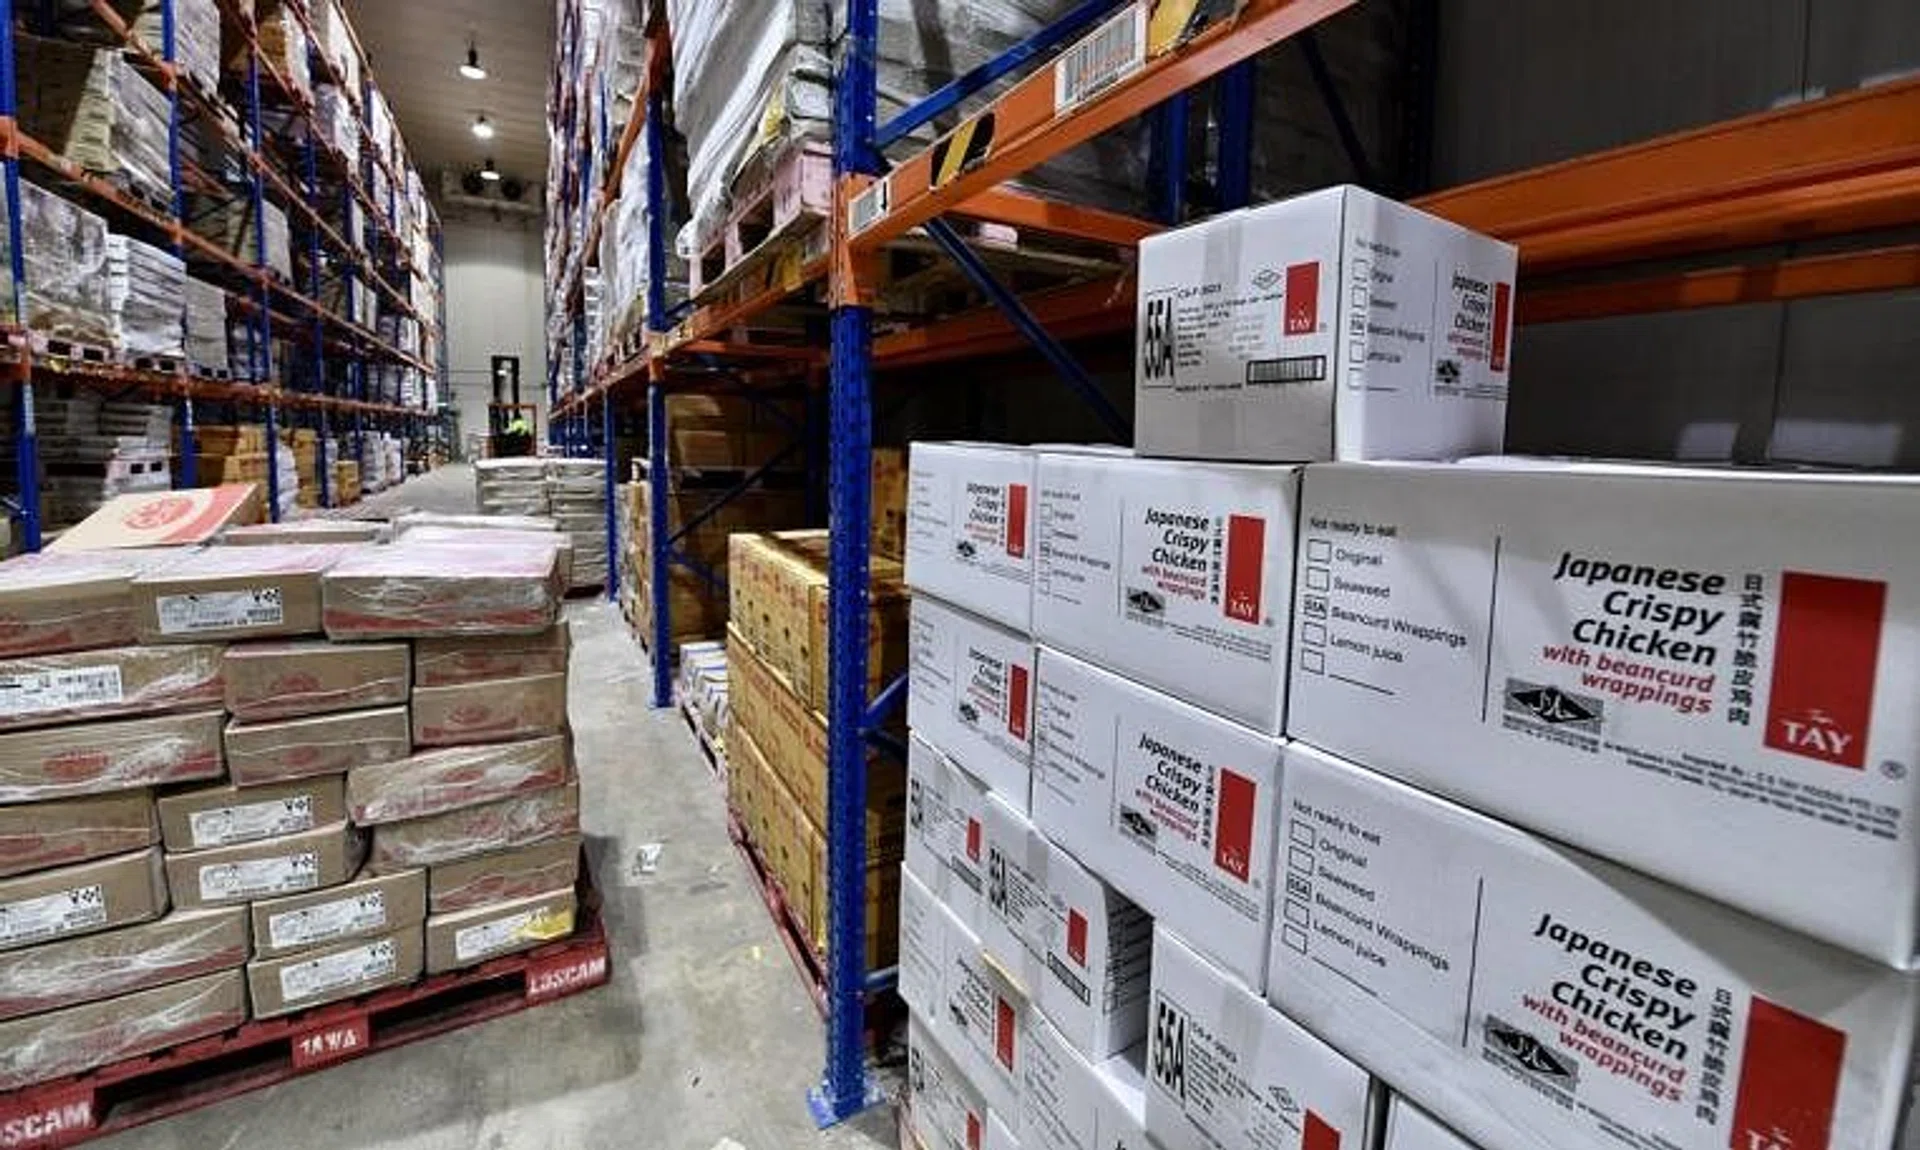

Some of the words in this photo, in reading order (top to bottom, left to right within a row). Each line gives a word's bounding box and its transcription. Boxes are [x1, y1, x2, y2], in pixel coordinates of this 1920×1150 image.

[1289, 319, 1311, 332] TAY
[1145, 508, 1209, 532] Japanese
[1310, 517, 1328, 531] Not
[1329, 520, 1360, 537] ready
[1363, 523, 1375, 535] to
[1152, 547, 1207, 572] Chicken
[1163, 529, 1209, 554] Crispy
[1335, 548, 1383, 567] Original
[1334, 576, 1391, 599] Seaweed
[1553, 551, 1726, 596] Japanese
[1331, 605, 1390, 631] Beancurd
[1392, 619, 1467, 650] Wrappings
[1602, 590, 1725, 636] Crispy
[1330, 634, 1371, 656] Lemon
[1371, 644, 1404, 664] juice
[1571, 618, 1717, 667] Chicken
[1542, 644, 1592, 668] with
[1596, 652, 1717, 693] beancurd
[1580, 672, 1714, 714] wrappings
[1138, 733, 1202, 774] Japanese
[1781, 719, 1854, 756] TAY
[1145, 775, 1199, 814] Chicken
[1157, 760, 1201, 795] Crispy
[1293, 799, 1312, 817] Not
[1314, 809, 1344, 831] ready
[1348, 822, 1360, 836] to
[1361, 830, 1381, 847] eat
[1318, 838, 1368, 868] Original
[1318, 865, 1376, 902] Seaweed
[1313, 918, 1355, 949] Lemon
[1356, 942, 1387, 968] juice
[1315, 892, 1374, 931] Beancurd
[1376, 922, 1451, 971] Wrappings
[1532, 912, 1699, 999] Japanese
[1580, 963, 1697, 1031] Crispy
[1522, 993, 1569, 1026] with
[1573, 1018, 1687, 1085] beancurd
[1551, 980, 1688, 1061] Chicken
[1558, 1030, 1686, 1102] wrappings
[0, 1101, 91, 1147] SCAM
